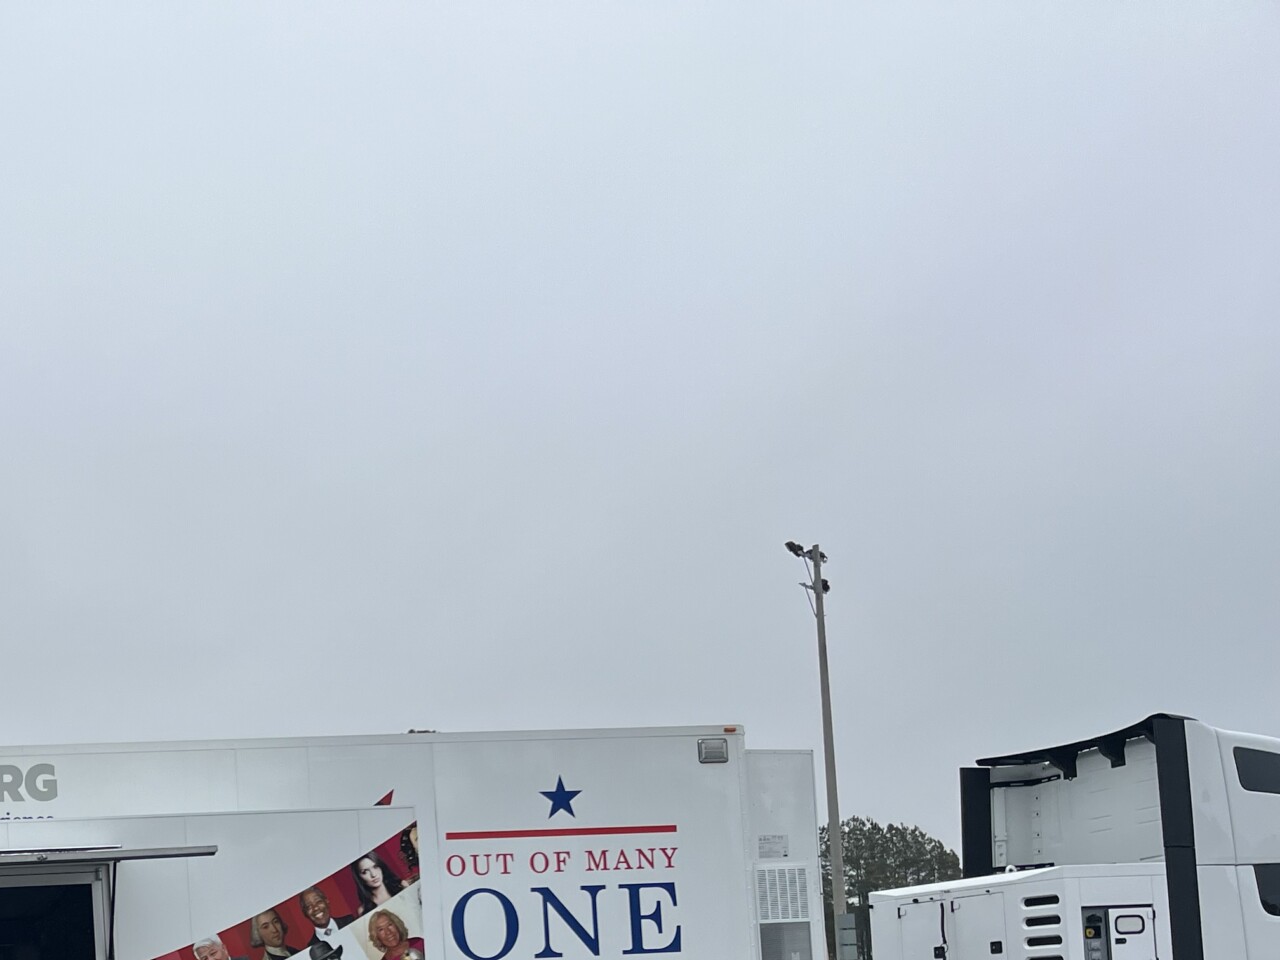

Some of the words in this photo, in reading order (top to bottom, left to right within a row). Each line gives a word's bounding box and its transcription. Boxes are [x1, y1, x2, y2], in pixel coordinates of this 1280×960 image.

[446, 853, 514, 876] OUT
[529, 851, 570, 873] OF
[585, 847, 678, 871] MANY
